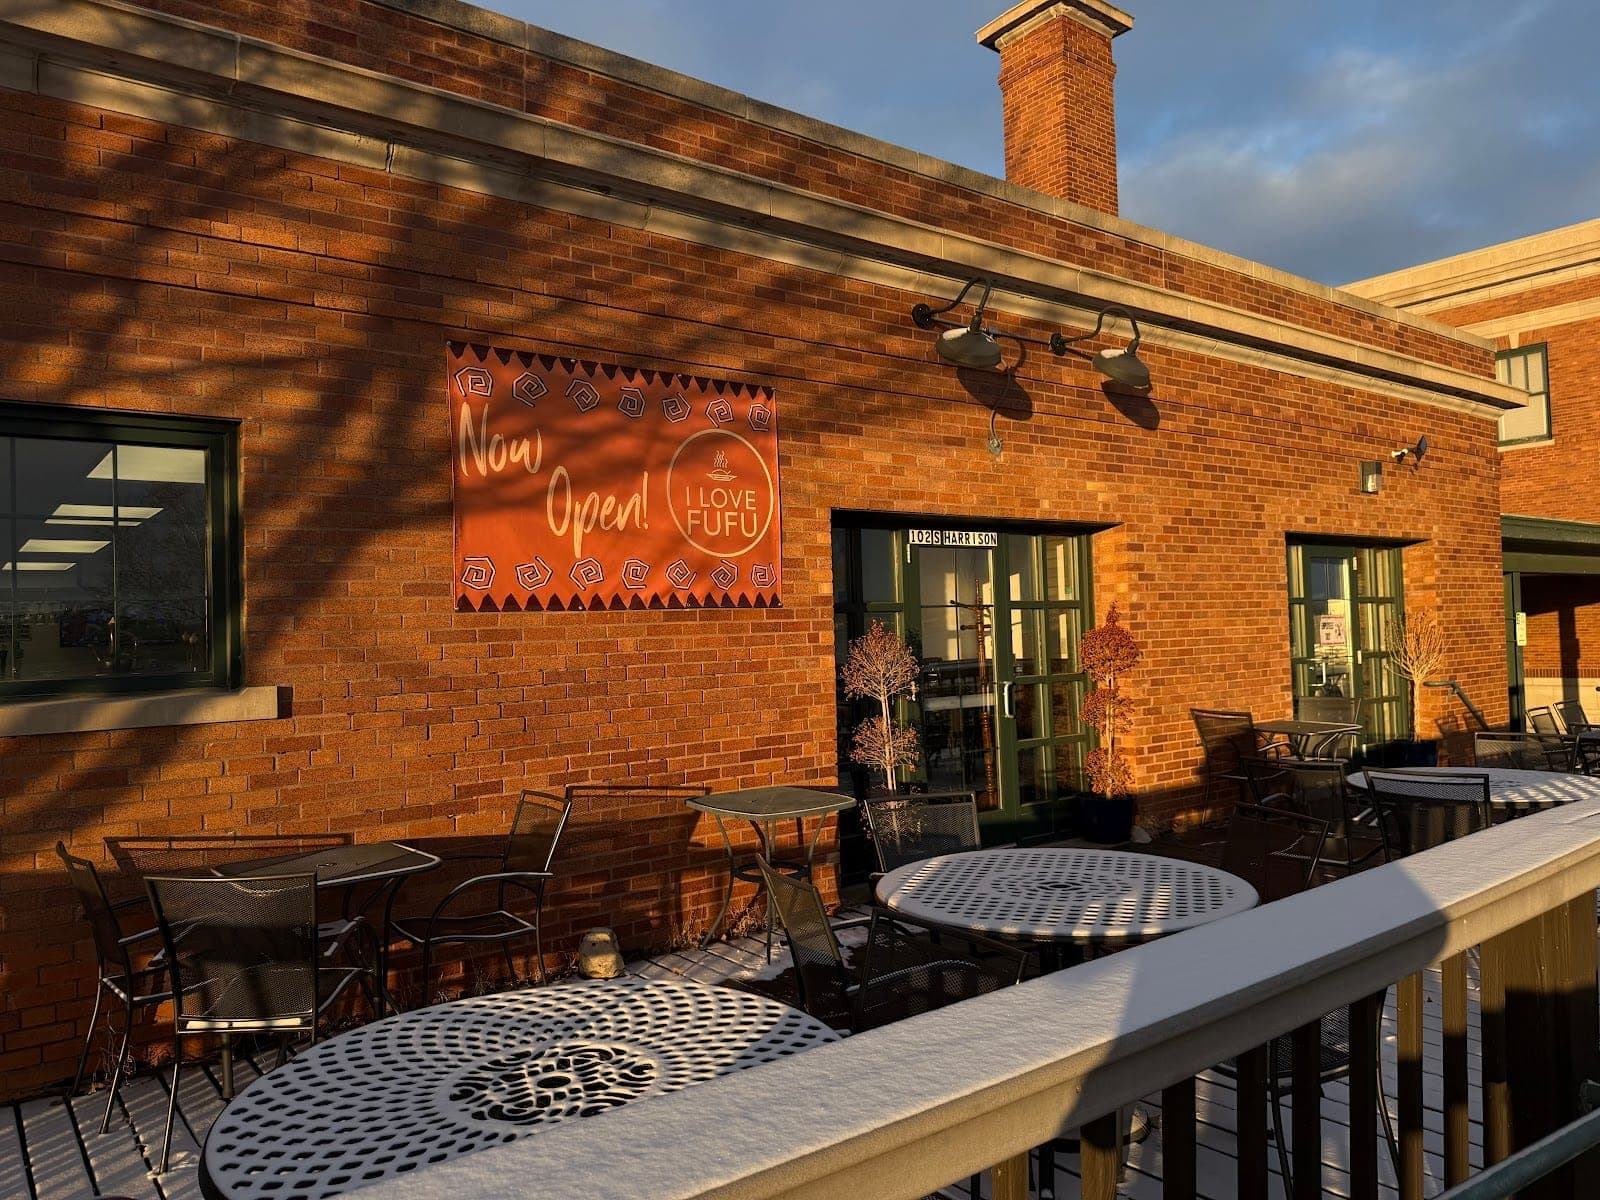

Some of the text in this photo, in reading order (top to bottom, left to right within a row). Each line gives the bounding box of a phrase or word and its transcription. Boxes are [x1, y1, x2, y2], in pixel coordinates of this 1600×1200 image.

[459, 402, 542, 477] Now
[546, 466, 649, 558] Open!
[685, 486, 757, 510] I LOVE
[687, 509, 758, 537] FUFU
[911, 530, 996, 545] 102 S HARRISON
